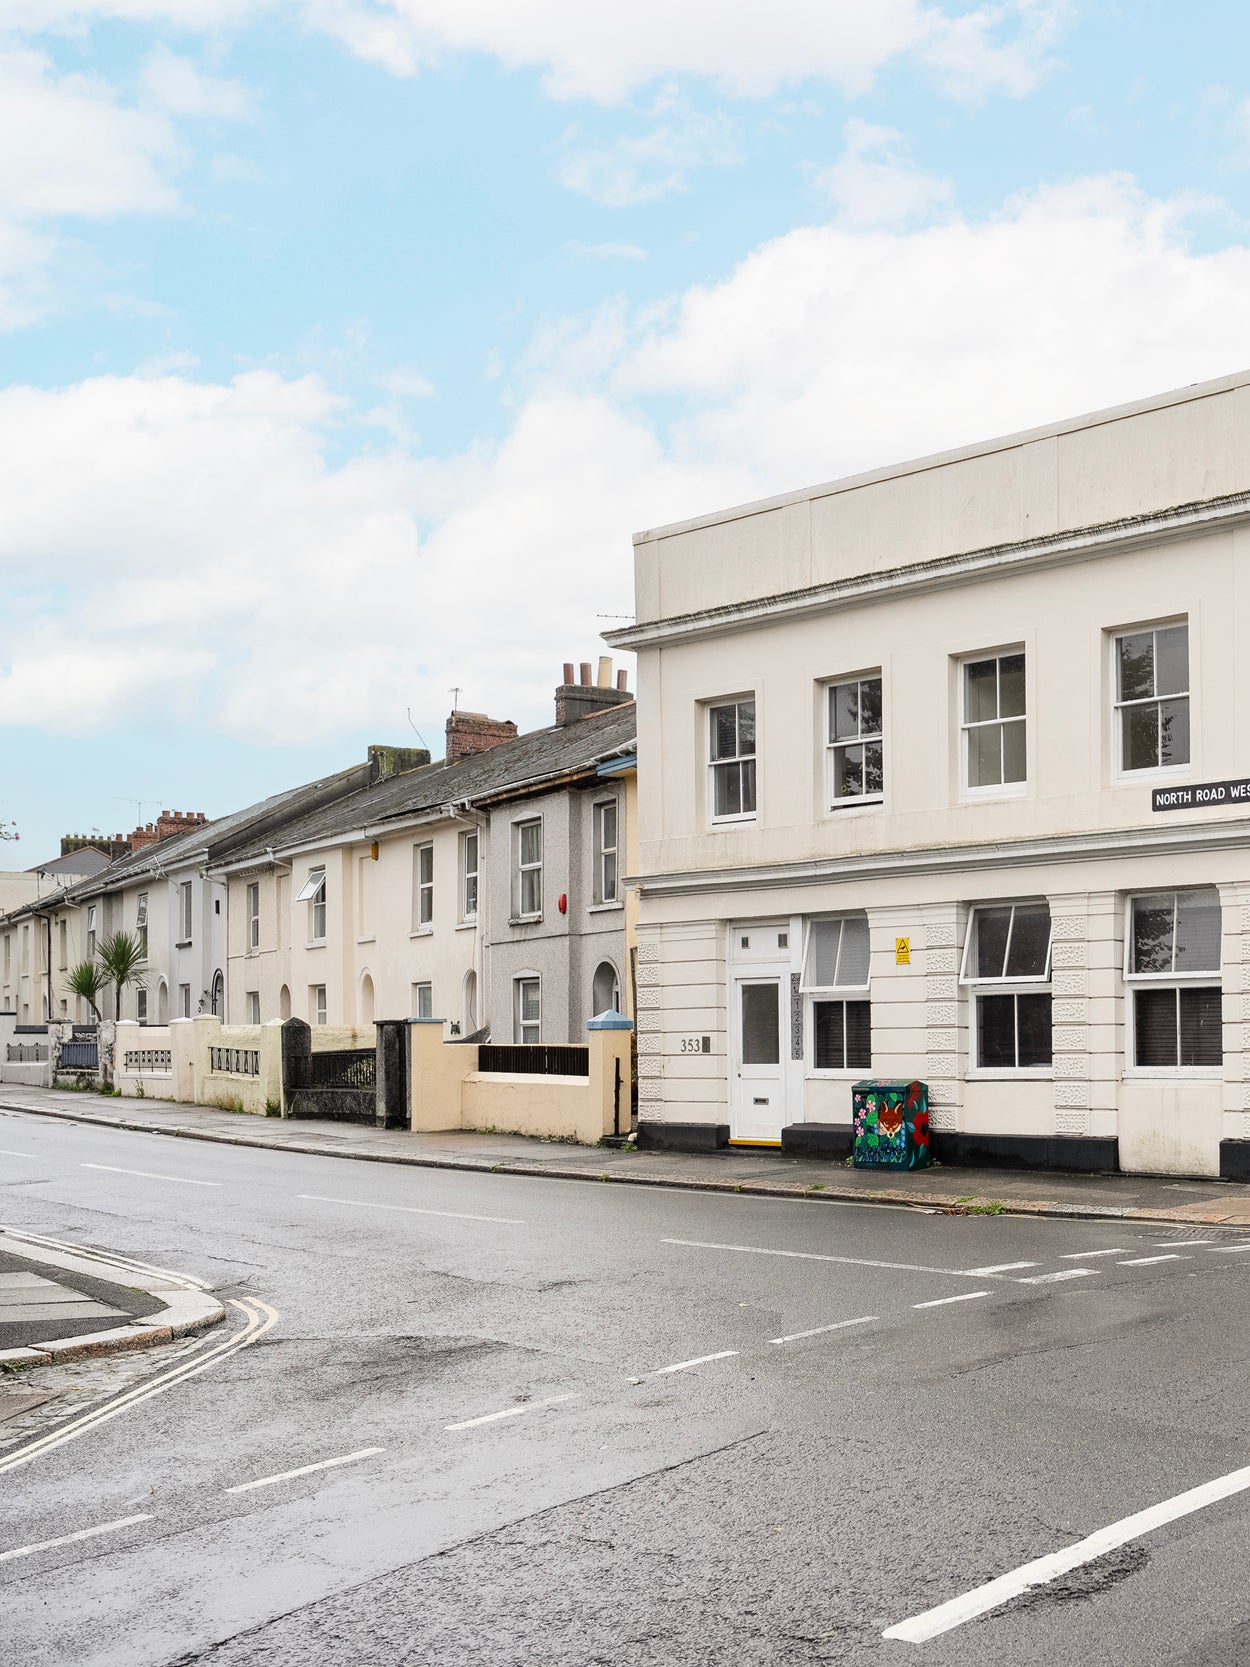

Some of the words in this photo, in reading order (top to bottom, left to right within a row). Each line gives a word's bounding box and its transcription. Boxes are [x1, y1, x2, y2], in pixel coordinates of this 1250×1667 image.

[1156, 790, 1192, 806] NORTH
[1196, 787, 1226, 802] ROAD
[795, 1014, 800, 1022] 2
[795, 1026, 800, 1034] 3
[680, 1039, 700, 1052] 353
[795, 1038, 800, 1046] 4
[795, 1051, 800, 1059] 5
